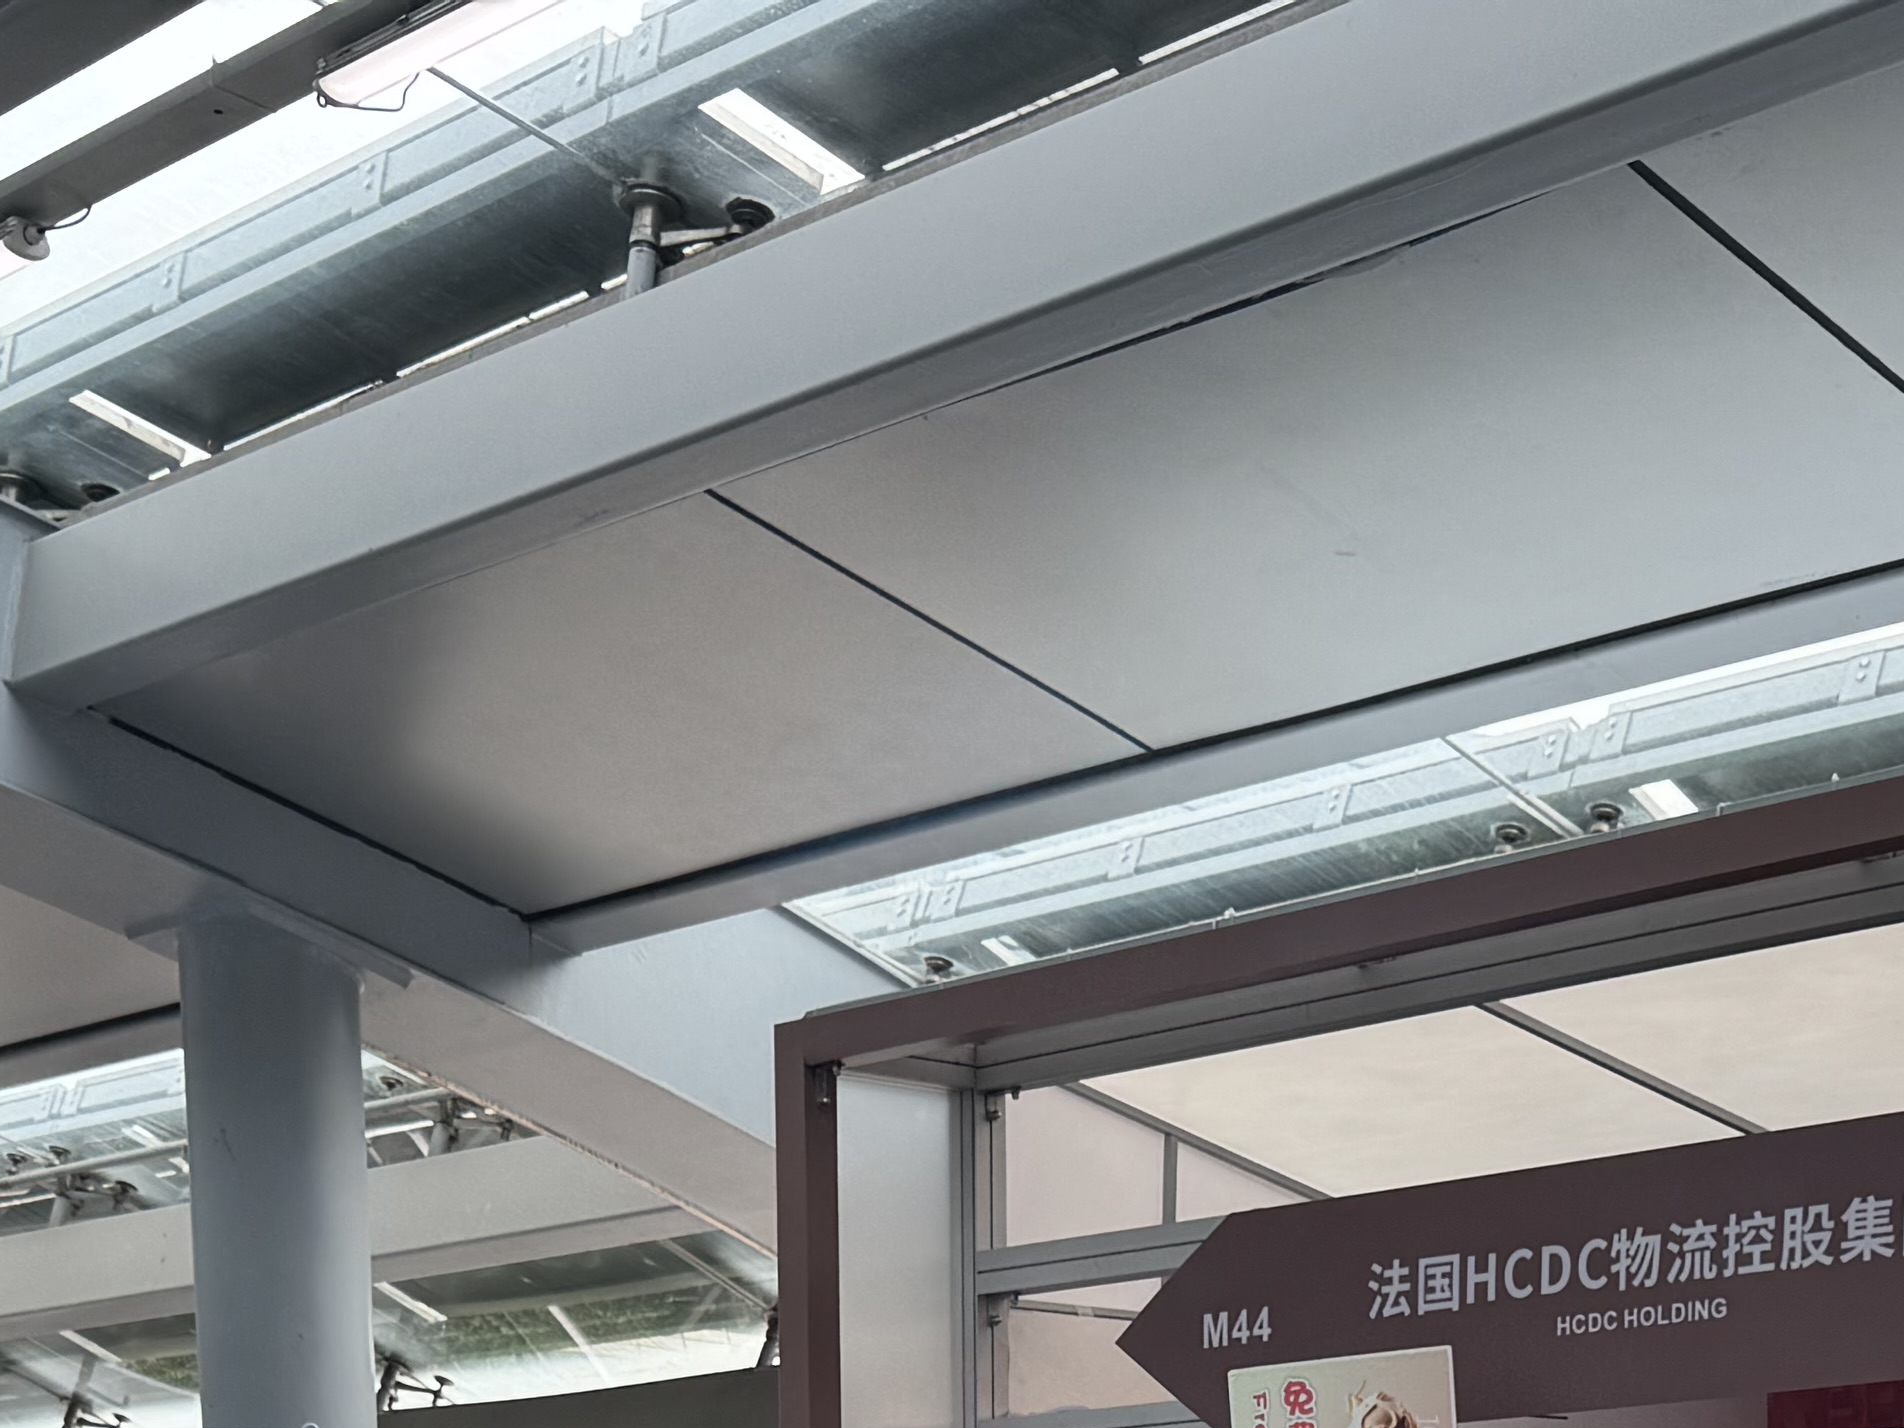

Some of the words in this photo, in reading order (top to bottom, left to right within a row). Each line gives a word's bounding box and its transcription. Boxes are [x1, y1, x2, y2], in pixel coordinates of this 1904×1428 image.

[1201, 1306, 1272, 1350] M44
[1556, 1308, 1618, 1336] HCDC
[1623, 1296, 1728, 1330] HOLDING
